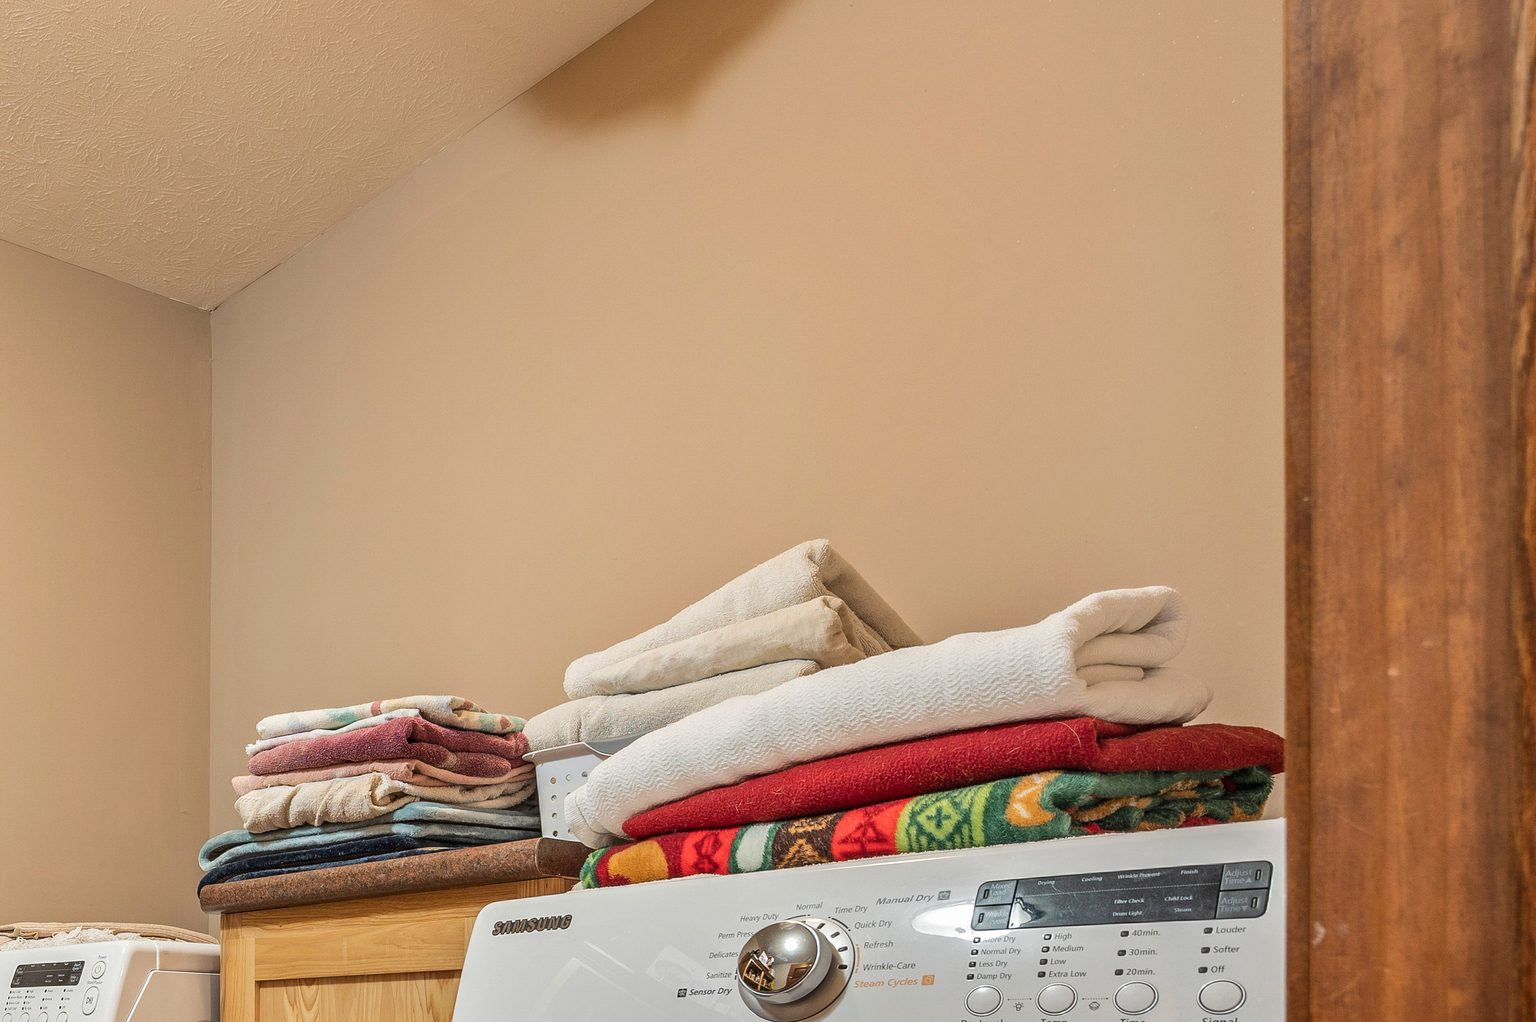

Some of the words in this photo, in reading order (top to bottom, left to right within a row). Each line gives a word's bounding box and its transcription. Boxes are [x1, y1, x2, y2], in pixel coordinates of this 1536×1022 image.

[1117, 872, 1138, 880] Wrinkle
[1139, 871, 1160, 879] Prevent
[1224, 868, 1252, 878] Adjust
[1224, 876, 1244, 884] Time
[990, 882, 1014, 890] Mixed
[876, 895, 913, 906] Manual
[915, 893, 934, 904] Dry
[1221, 896, 1248, 906] Adjust
[796, 902, 823, 911] Normal
[835, 906, 851, 914] Time
[853, 904, 868, 914] Dry
[1220, 904, 1241, 913] Time
[740, 915, 759, 923] Heavy
[761, 913, 779, 922] Duty
[492, 914, 573, 936] SAMSUNG
[854, 921, 874, 930] Quick
[876, 920, 892, 928] Dry
[1216, 925, 1246, 934] Louder
[736, 930, 754, 938] Press
[1054, 932, 1072, 941] High
[1132, 928, 1161, 938] 40min.
[863, 940, 893, 949] Refresh
[1000, 935, 1016, 945] Dry
[980, 947, 1007, 956] Normal
[1008, 947, 1022, 956] Dry
[1053, 944, 1084, 953] Medium
[1129, 947, 1158, 957] 30min.
[1213, 944, 1240, 954] Softer
[709, 951, 738, 959] Delicates
[863, 961, 916, 971] Wrinkle-Care
[979, 960, 993, 968] Less
[995, 960, 1008, 969] Dry
[1050, 957, 1067, 966] Low
[1126, 967, 1155, 976] 20min.
[1211, 964, 1225, 974] Off
[706, 971, 732, 979] Sanitize
[977, 972, 996, 981] Damp
[999, 972, 1012, 981] Dry
[1048, 970, 1067, 979] Extra
[1070, 969, 1087, 977] Low
[853, 980, 884, 989] Steam
[887, 977, 918, 988] Cycles
[689, 988, 716, 996] Sensor
[718, 987, 732, 996] Dry
